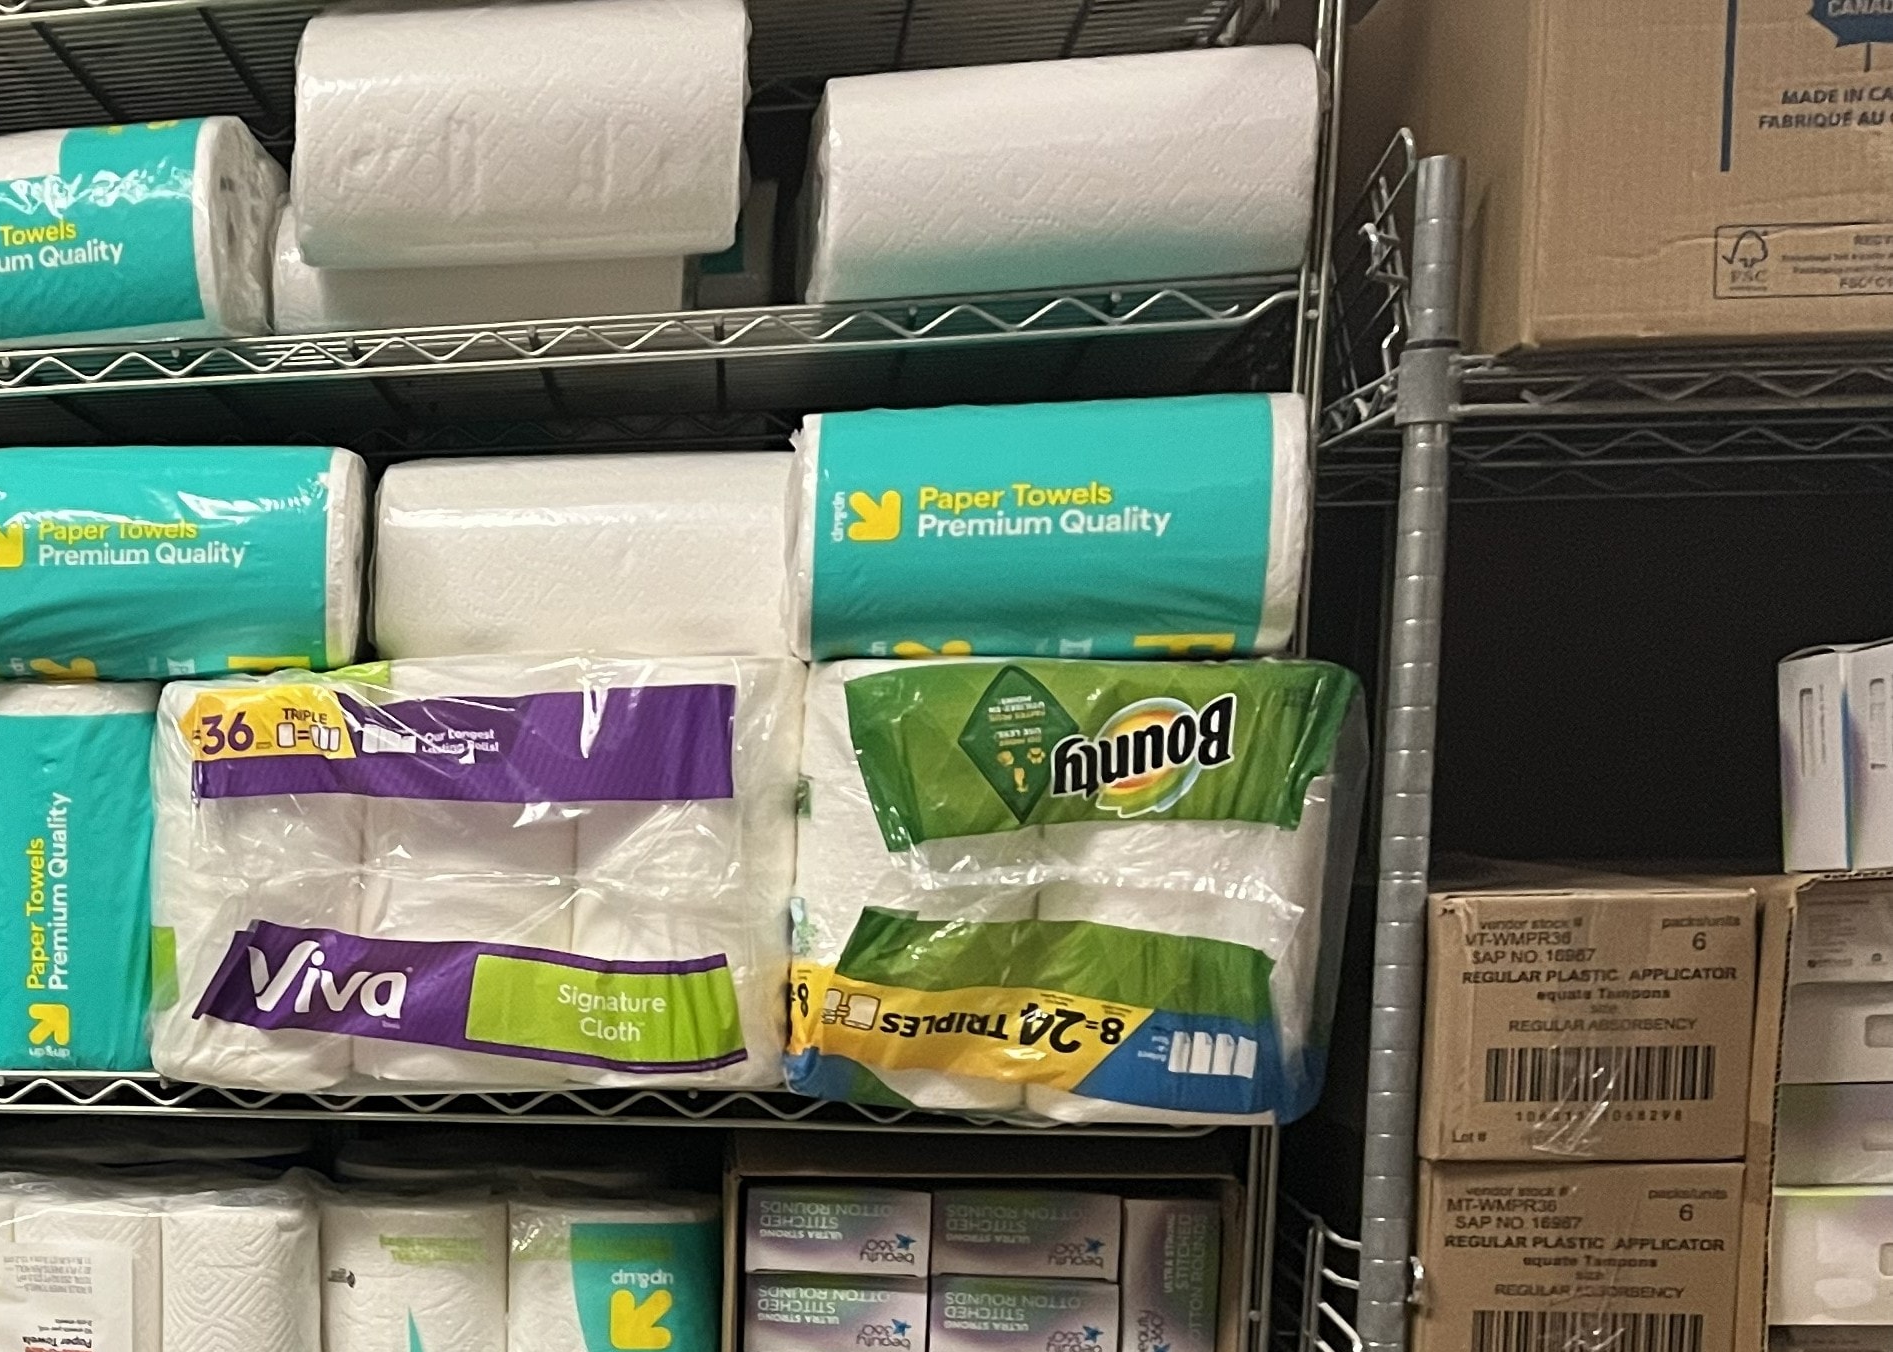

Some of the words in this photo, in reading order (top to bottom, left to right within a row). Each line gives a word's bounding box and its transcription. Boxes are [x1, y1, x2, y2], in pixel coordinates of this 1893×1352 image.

[1781, 89, 1838, 105] MADE
[1844, 89, 1863, 103] IN
[1759, 111, 1853, 129] FABRIQUE
[1858, 110, 1884, 127] AU
[0, 219, 77, 247] Towels
[38, 238, 124, 268] Quality
[918, 484, 1005, 514] Paper
[1012, 481, 1113, 507] Towels
[38, 520, 109, 544] Paper
[118, 519, 198, 539] Towels
[917, 510, 1052, 539] Premium
[1059, 508, 1172, 537] Quality
[38, 542, 149, 567] Premium
[156, 541, 246, 568] Quality
[282, 707, 328, 725] TRIPLE
[1051, 694, 1236, 798] Bounty
[48, 791, 74, 878] Quality
[25, 837, 46, 918] Towels
[48, 885, 70, 992] Premium
[1691, 931, 1707, 951] 6
[26, 928, 46, 991] Paper
[1472, 949, 1506, 965] SAP
[248, 940, 409, 1019] Viva
[1462, 969, 1541, 985] REGULAR
[1546, 967, 1618, 984] PLASTIC
[1629, 966, 1737, 982] APPLICATOR
[557, 983, 668, 1016] Signature
[580, 1017, 645, 1044] Cloth
[881, 1011, 1008, 1040] TRIPLES
[1509, 1018, 1584, 1033] REGULAR
[1588, 1017, 1698, 1032] ABSORBENCY
[1456, 1216, 1492, 1230] SAP
[1679, 1204, 1694, 1222] 6
[1444, 1235, 1526, 1249] REGULAR
[1533, 1236, 1604, 1250] PLASTIC
[1616, 1237, 1724, 1251] APPLICATOR
[1495, 1284, 1570, 1298] REGULAR
[60, 1337, 93, 1349] Paper
